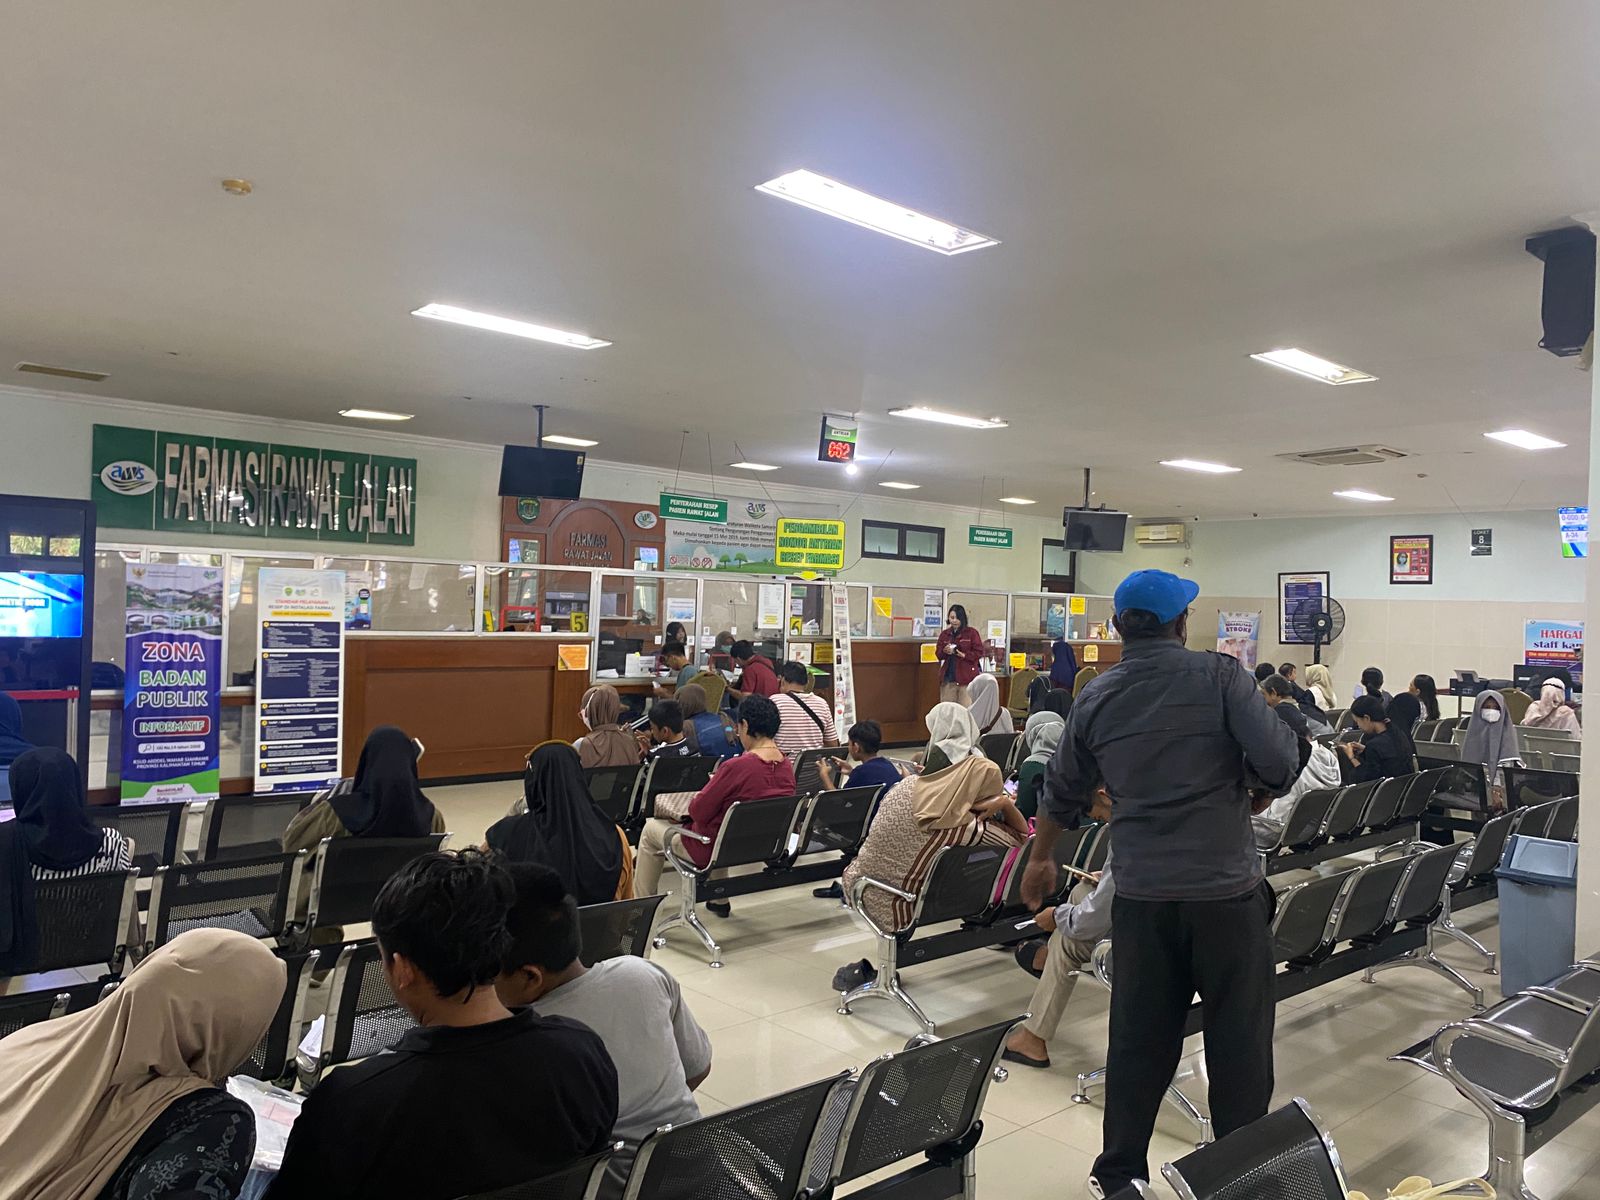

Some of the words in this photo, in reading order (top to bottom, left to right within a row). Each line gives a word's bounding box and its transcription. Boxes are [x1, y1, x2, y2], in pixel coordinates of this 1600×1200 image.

[110, 464, 144, 481] aws
[163, 442, 267, 527] FARMASI
[269, 454, 345, 530] RAWAT
[347, 462, 412, 534] JALAN
[670, 499, 703, 509] PENYERAHAN
[703, 502, 718, 510] RESEP
[668, 506, 686, 515] PASIEN
[704, 510, 719, 518] JALAN
[784, 522, 838, 535] PENGAMBILAN
[779, 536, 808, 548] NOMOR
[808, 538, 842, 550] ANTRIAN
[1478, 536, 1484, 544] 8
[564, 549, 590, 560] RAWAT
[590, 550, 612, 562] JALAN
[780, 552, 804, 562] RESEP
[805, 553, 840, 564] FARMASI
[574, 616, 584, 632] 5
[792, 620, 800, 634] 6
[1540, 630, 1583, 640] HARGAI
[1533, 640, 1558, 649] staff
[142, 642, 206, 662] ZONA
[140, 670, 206, 686] BADAN
[136, 690, 208, 708] PUBLIK
[140, 720, 206, 733] INFORMATIF
